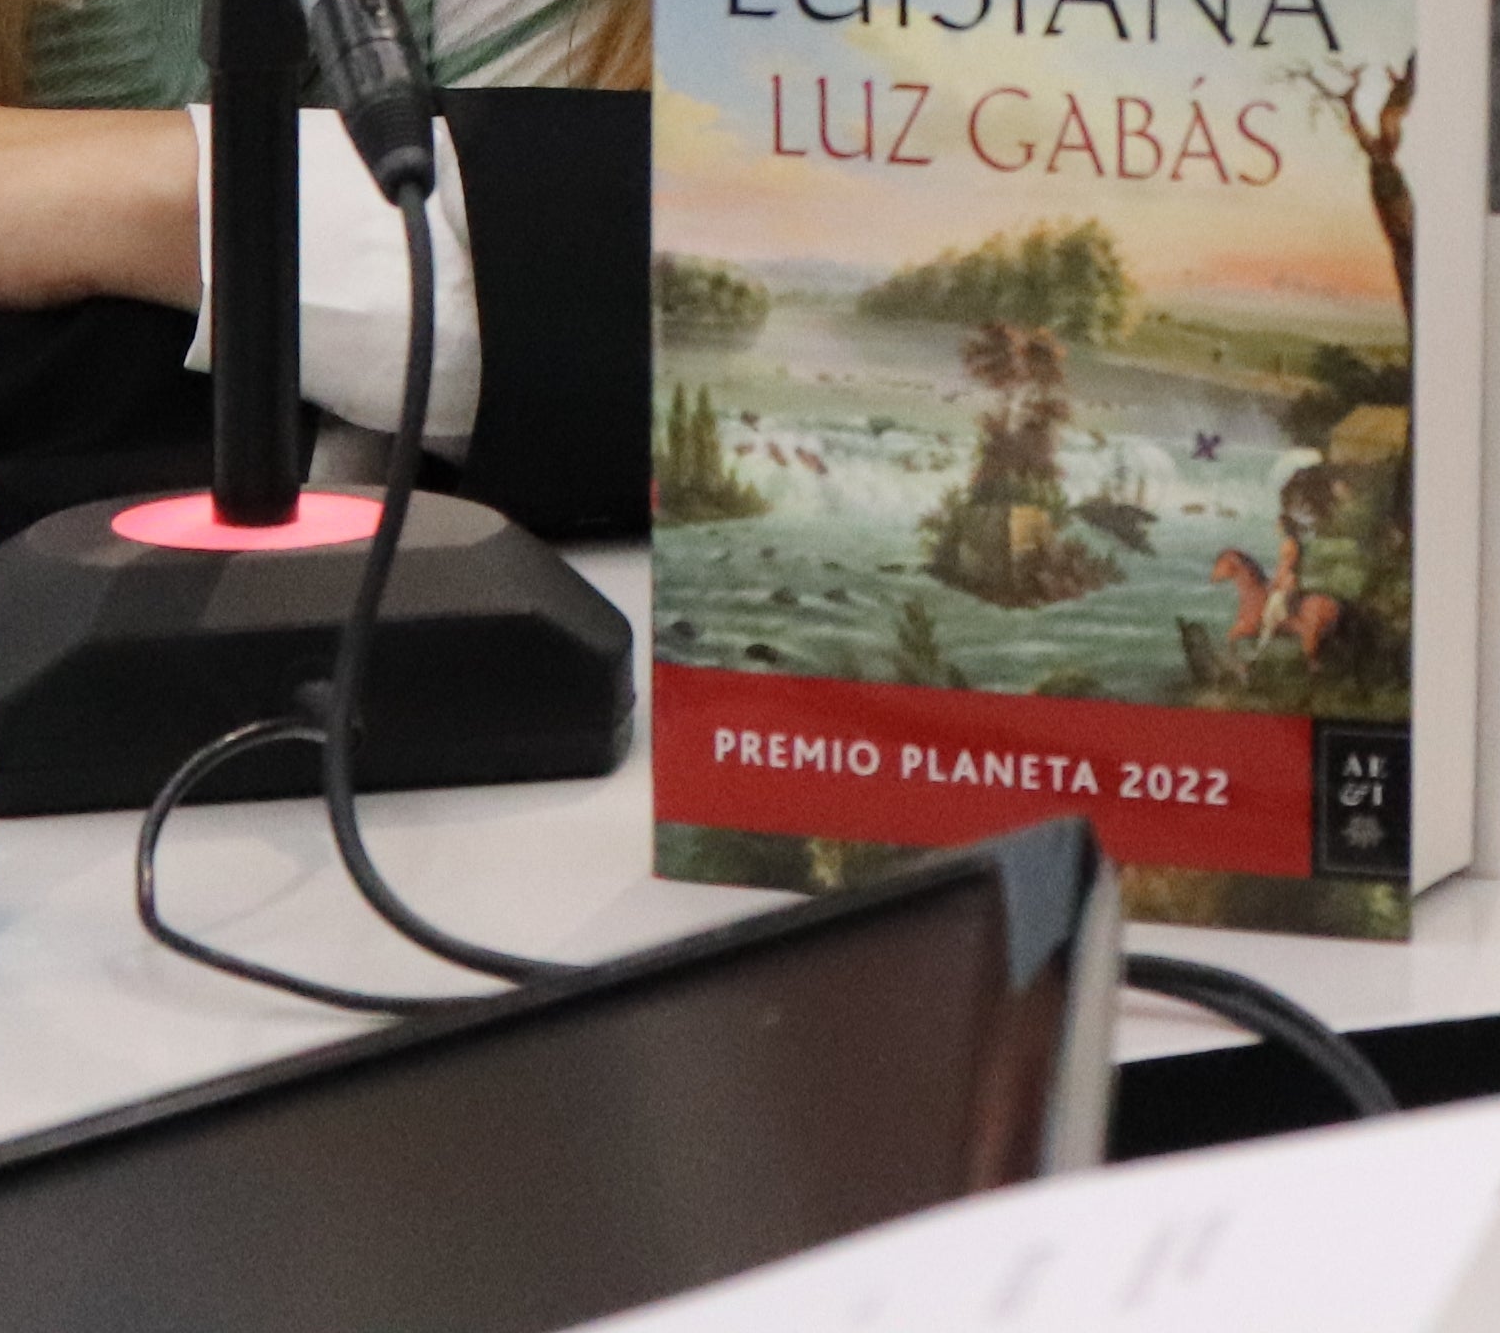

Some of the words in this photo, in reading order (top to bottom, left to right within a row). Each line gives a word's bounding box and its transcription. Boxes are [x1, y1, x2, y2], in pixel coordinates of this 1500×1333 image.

[772, 74, 932, 167] LUZ
[969, 78, 1283, 187] GABÁS
[714, 729, 881, 776] PREMIO
[901, 744, 1099, 795] PLANETA
[1120, 762, 1230, 806] 2022
